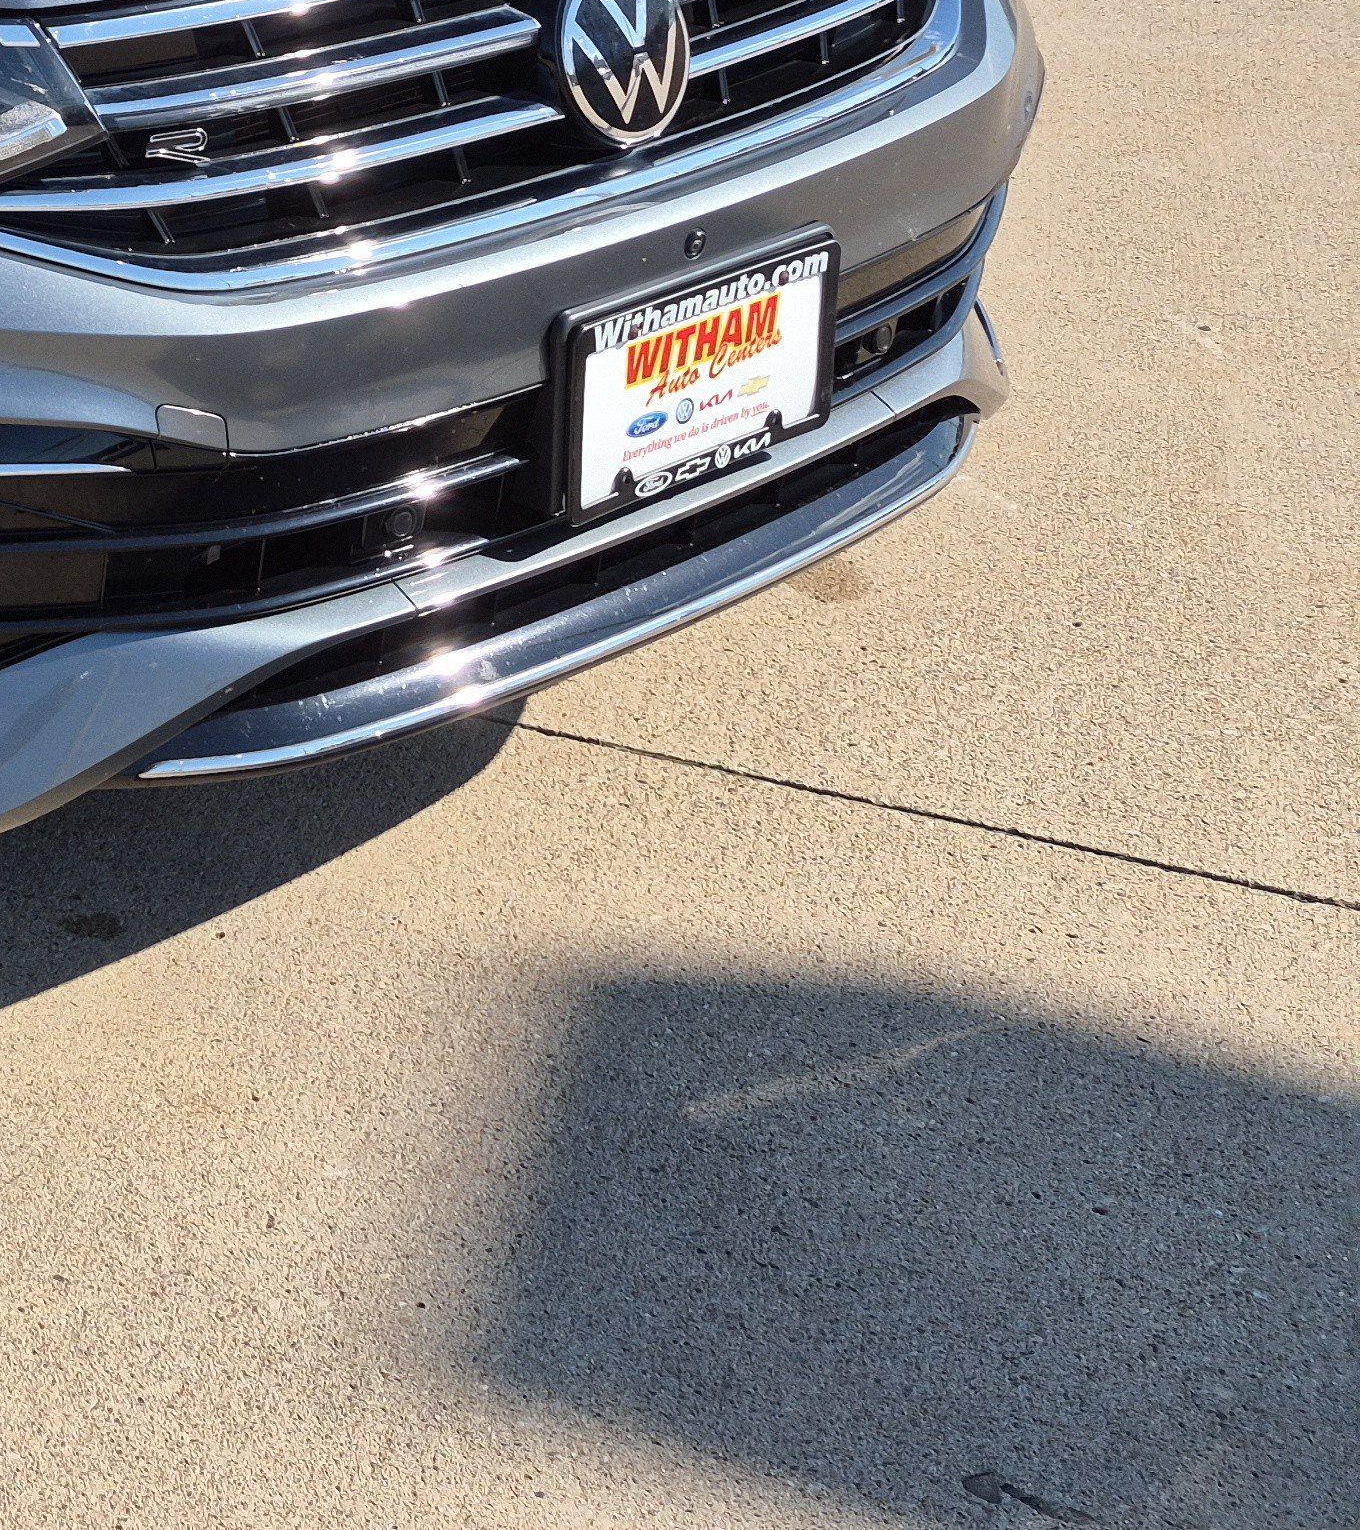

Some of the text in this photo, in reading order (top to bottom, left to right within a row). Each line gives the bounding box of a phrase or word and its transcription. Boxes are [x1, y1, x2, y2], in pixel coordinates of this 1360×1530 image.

[594, 251, 829, 354] Withamauto.com
[625, 293, 780, 387] WITHAM
[646, 328, 783, 407] Auto Centers
[623, 436, 673, 462] Everything
[711, 413, 739, 430] driven
[631, 414, 664, 437] Ford
